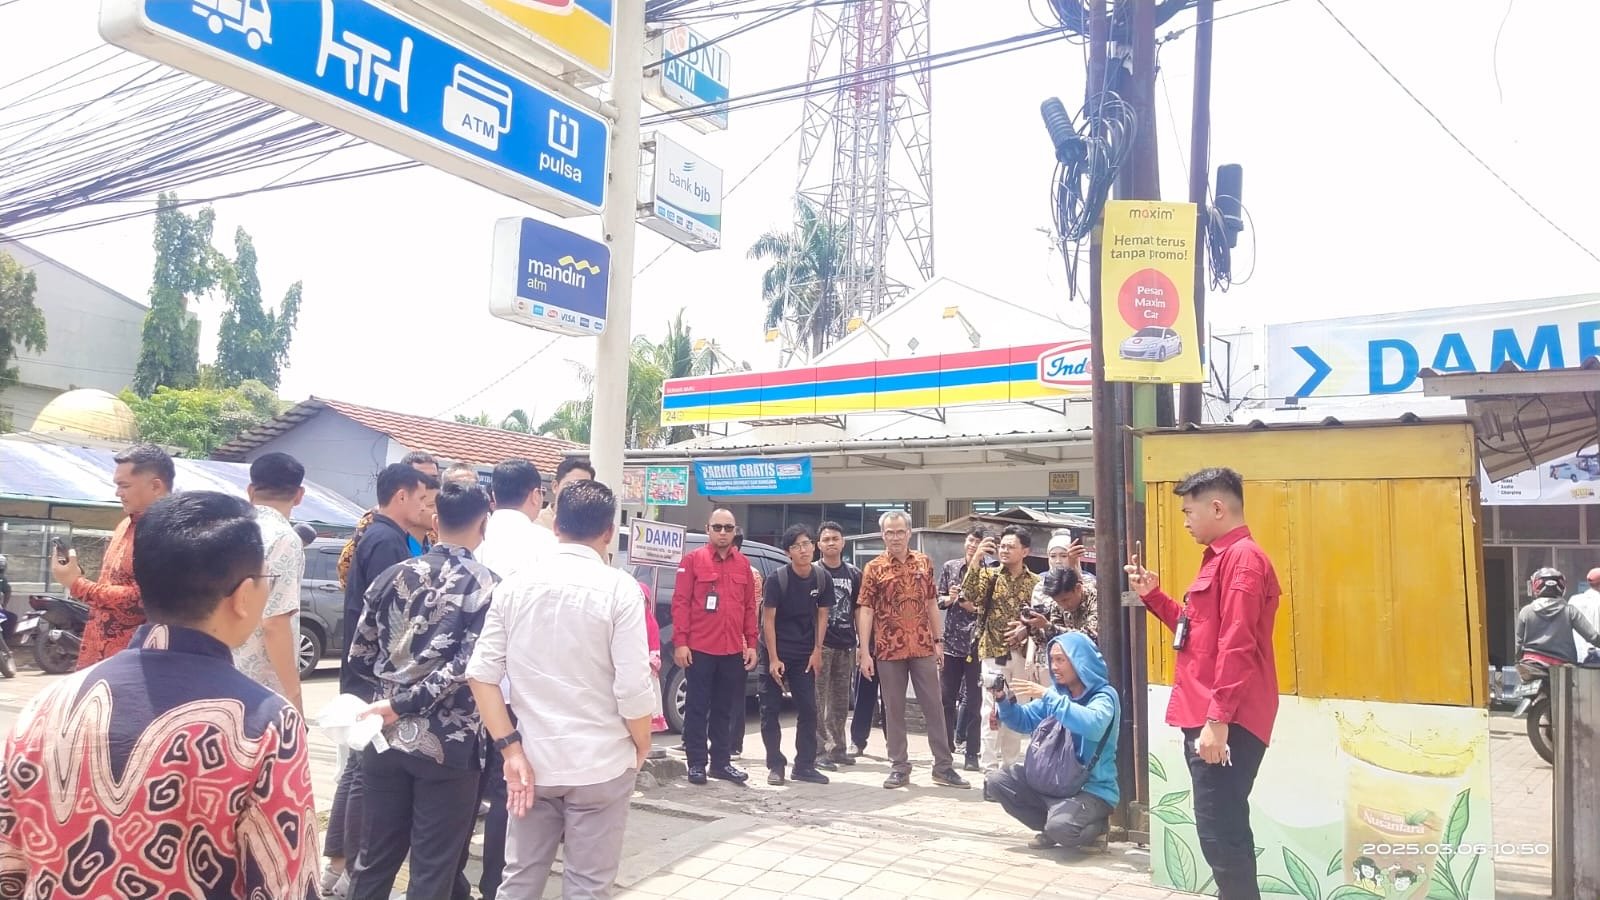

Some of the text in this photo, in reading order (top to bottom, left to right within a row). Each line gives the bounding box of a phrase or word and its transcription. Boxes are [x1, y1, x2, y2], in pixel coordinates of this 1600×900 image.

[687, 32, 723, 83] BNI
[666, 58, 696, 92] ATM
[462, 113, 495, 139] ATM
[539, 152, 582, 183] pulsa
[668, 168, 712, 203] bank bjb
[1129, 208, 1173, 220] maxim
[1114, 235, 1186, 248] Hemat terus
[1111, 249, 1188, 261] tanpa promo!
[528, 258, 586, 289] mandiri
[527, 278, 547, 293] atm
[1137, 285, 1164, 296] Pesan
[1134, 298, 1166, 309] Maxim
[561, 313, 576, 324] VISA
[1143, 310, 1160, 319] Car
[1367, 321, 1600, 395] DAM
[702, 463, 738, 479] PARKIR
[739, 462, 776, 478] GRATIS
[645, 527, 682, 548] DAMRI
